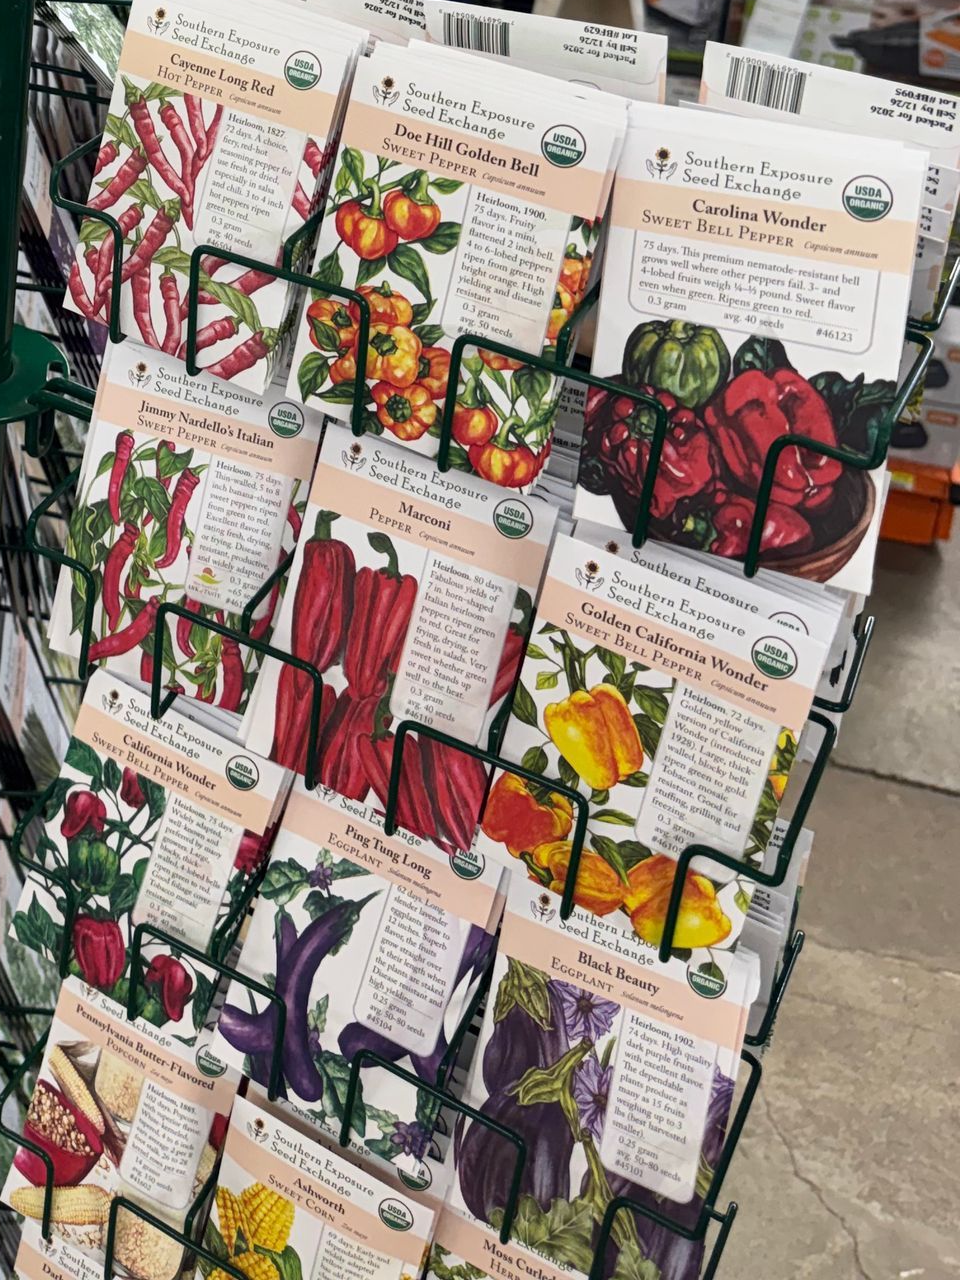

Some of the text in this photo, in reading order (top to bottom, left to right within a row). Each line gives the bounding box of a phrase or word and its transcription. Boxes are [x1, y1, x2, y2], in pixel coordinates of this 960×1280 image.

[170, 53, 275, 97] Cayenne Long Red
[870, 104, 953, 132] Packed for 2026
[890, 98, 956, 120] Sell by 12/26
[895, 87, 958, 109] Lot #BF095
[394, 123, 540, 178] Doe Hill Golden Bell
[685, 151, 833, 188] Southern Exposure
[682, 168, 801, 201] Seed Exchange
[849, 197, 885, 211] ORGANIC
[854, 185, 882, 199] USDA
[693, 198, 827, 233] Carolina Wonder
[643, 240, 860, 286] 75 days. This premium nematode-resistant bell
[647, 295, 853, 343] 0.3 gram avg. 40 seeds #46123
[138, 400, 274, 449] Jimmy Nardello's Italian
[399, 501, 451, 532] Marconi
[580, 601, 769, 693] Golden California Wonder
[123, 734, 216, 791] California Wonder
[344, 824, 432, 880] Ping Tung Long
[577, 950, 660, 997] Black Beauty
[76, 1003, 214, 1091] Pennsylvania Butter-Flavored
[292, 1176, 346, 1216] Ashworth
[483, 1239, 513, 1263] Moss
